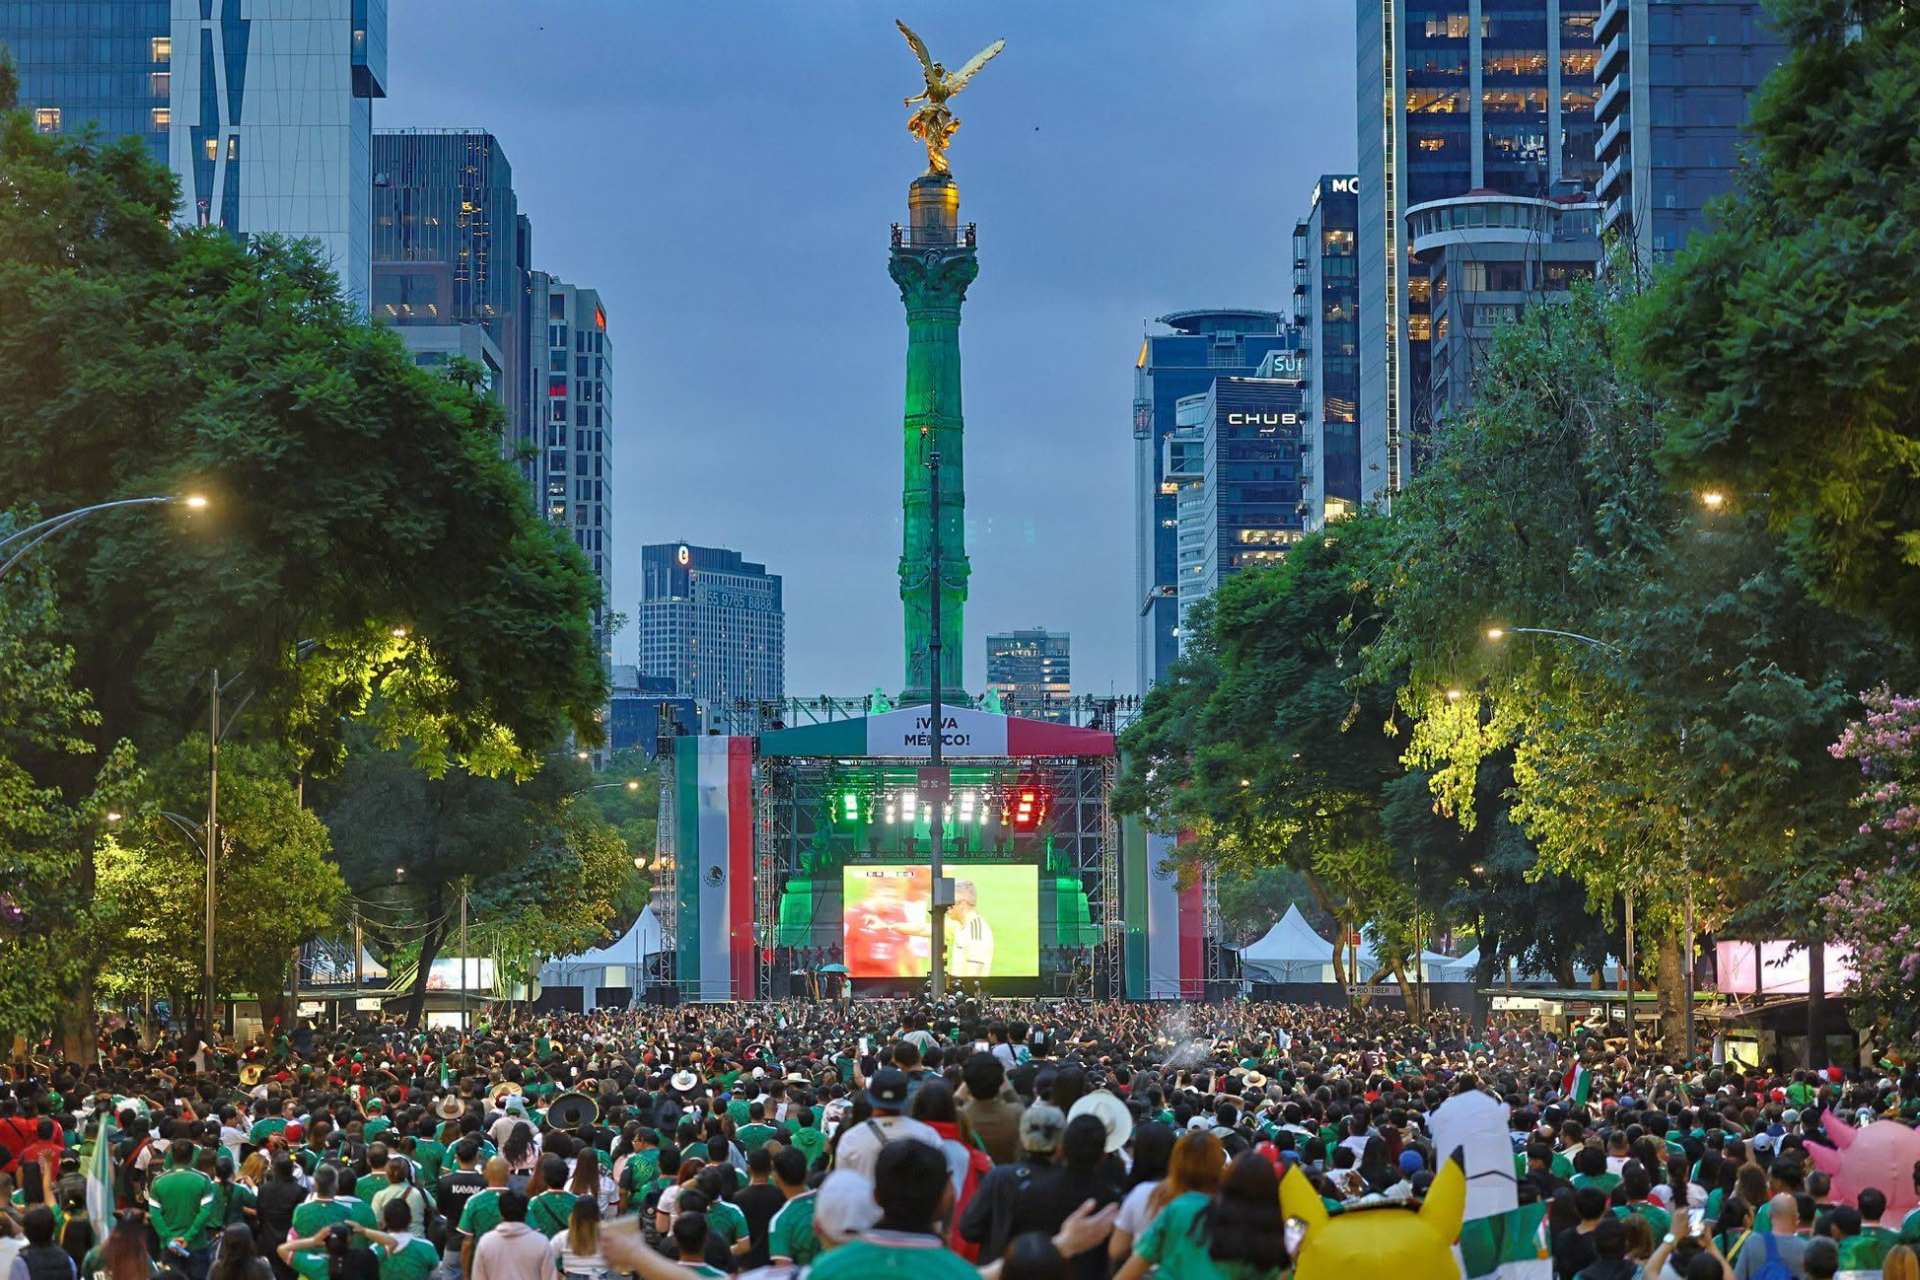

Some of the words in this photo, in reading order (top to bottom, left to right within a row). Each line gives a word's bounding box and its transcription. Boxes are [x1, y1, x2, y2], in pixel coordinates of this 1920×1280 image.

[1274, 355, 1302, 372] SU
[1228, 413, 1303, 425] CHUB
[916, 717, 958, 729] ¡VVA
[904, 731, 970, 746] MÉCO!
